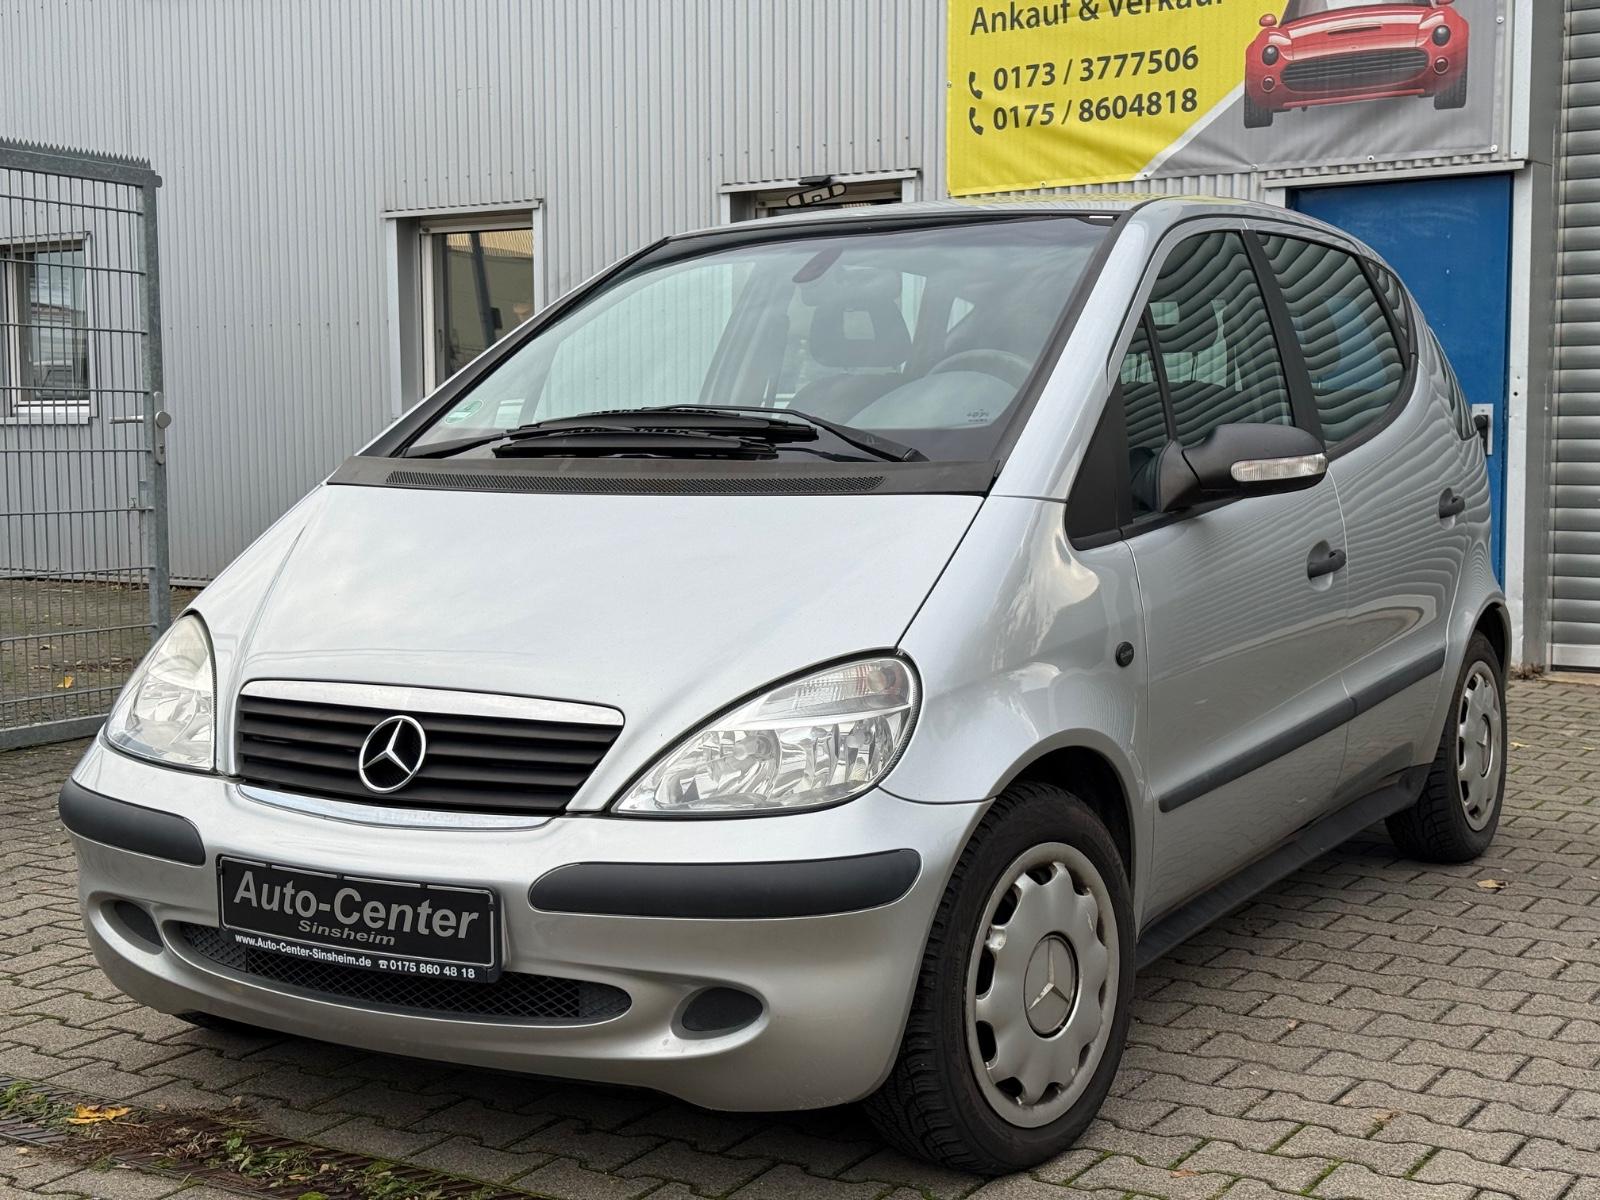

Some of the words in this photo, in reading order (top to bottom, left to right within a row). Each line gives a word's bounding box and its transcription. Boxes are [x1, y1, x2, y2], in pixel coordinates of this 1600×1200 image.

[970, 0, 1071, 35] Ankauf
[1078, 0, 1100, 21] &
[993, 62, 1056, 91] 0173
[1063, 59, 1073, 85] /
[1079, 45, 1199, 82] 3777506
[993, 103, 1055, 130] 0175
[1061, 100, 1072, 125] /
[1079, 88, 1198, 122] 8604818
[233, 871, 479, 939] Auto-Center
[298, 920, 395, 946] Sinsheim
[235, 933, 372, 967] www.Auto-Center-Sinsheim.de
[389, 960, 417, 972] 0175
[419, 963, 440, 975] 860
[443, 966, 458, 977] 48
[461, 968, 475, 979] 18
